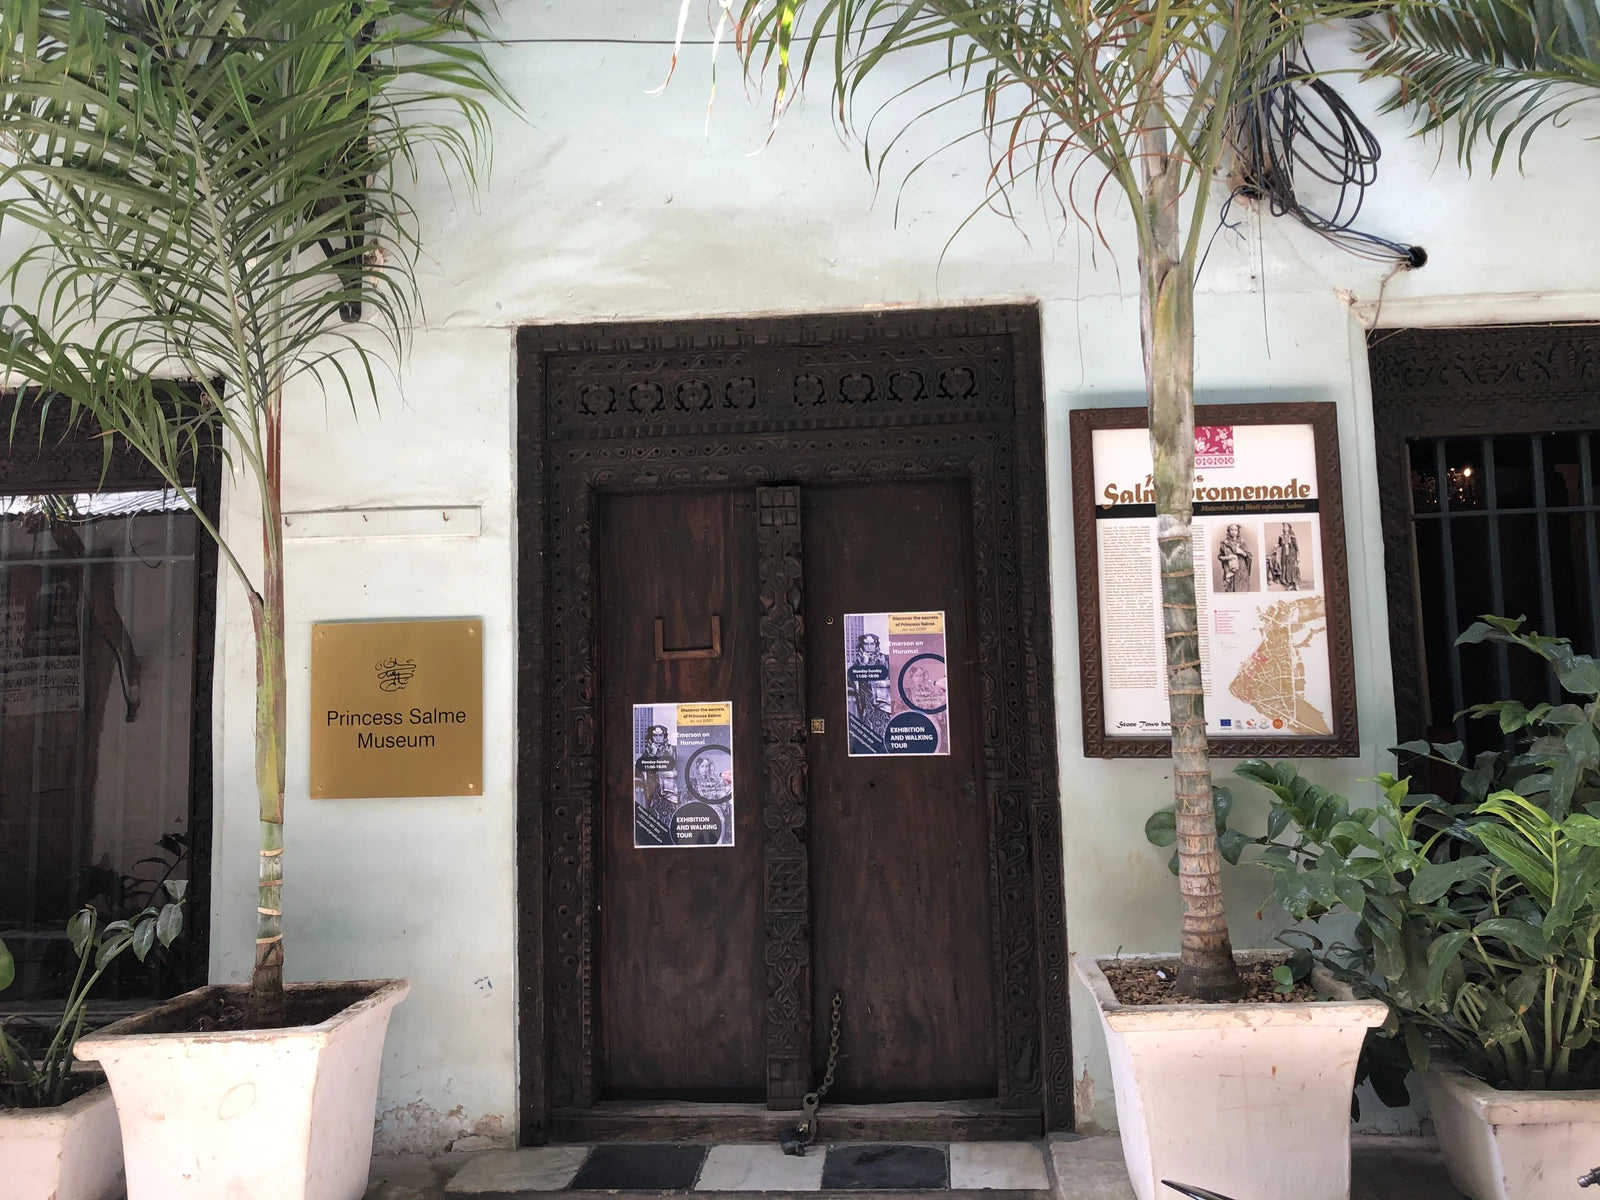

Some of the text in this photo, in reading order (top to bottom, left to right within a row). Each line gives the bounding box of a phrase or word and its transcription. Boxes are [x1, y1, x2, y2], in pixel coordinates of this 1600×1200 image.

[1101, 482, 1156, 510] Salm
[1192, 477, 1312, 501] romenade
[327, 708, 467, 726] Princess Salme
[357, 732, 435, 749] Museum
